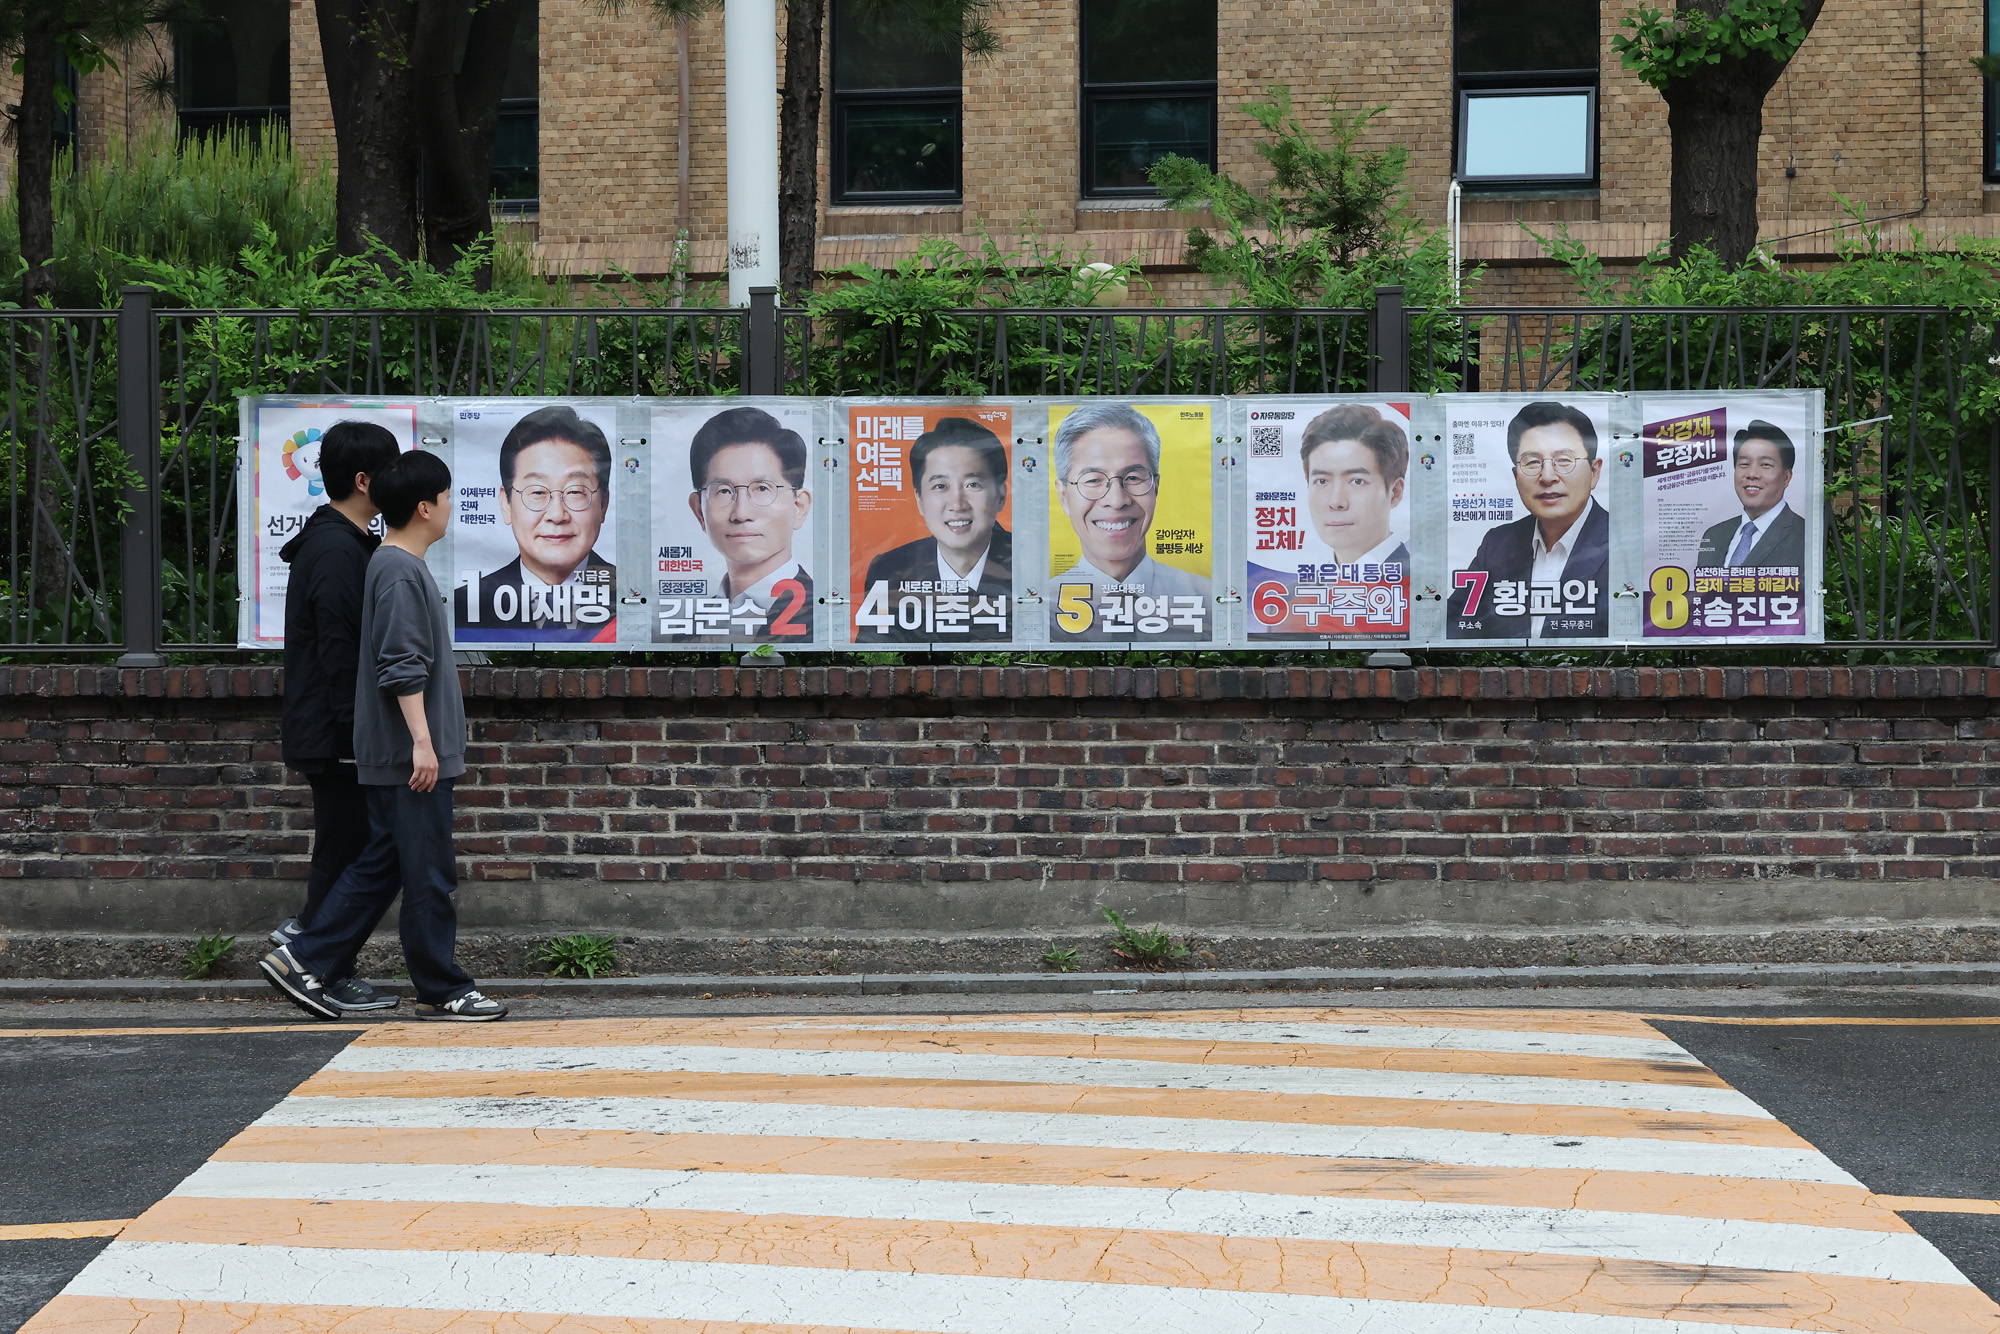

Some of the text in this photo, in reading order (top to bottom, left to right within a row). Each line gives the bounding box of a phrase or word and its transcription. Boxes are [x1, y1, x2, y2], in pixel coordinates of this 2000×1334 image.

[460, 412, 481, 420] 민주당
[1260, 411, 1295, 420] 자유통일당
[856, 416, 924, 441] 미래를
[1452, 420, 1505, 428] 출마엔 이유가 있다!
[1656, 415, 1715, 445] 선경제,
[856, 442, 902, 466] 여는
[1656, 438, 1717, 470] 후정치!
[856, 467, 902, 492] 선택
[460, 487, 496, 498] 이제부터
[1255, 491, 1296, 501] 광화문정신
[460, 501, 479, 512] 진짜
[1452, 498, 1514, 509] 부정선거 척결로
[460, 514, 496, 525] 대한민국
[1255, 507, 1296, 527] 정치
[1452, 510, 1513, 521] 청년에게 미래를
[267, 514, 308, 536] 선거
[1155, 529, 1195, 541] 갈아엎자!
[1255, 530, 1305, 550] 교체!
[658, 546, 692, 559] 새롭게
[1155, 543, 1203, 554] 불평등 세상
[658, 560, 703, 572] 대한민국
[1695, 567, 1799, 577] 실천하는 준비된 경제대통령
[573, 570, 610, 583] 지금은
[661, 582, 705, 594] 정정당당
[898, 580, 969, 593] 새로운 대통령
[1101, 583, 1145, 594] 진보대통령
[1695, 577, 1801, 593] 경제·금융 해결사
[461, 569, 611, 624] 1 이재명
[1454, 570, 1599, 616] 7 황교안
[1650, 566, 1800, 630] 8 송진호
[658, 579, 807, 636] 김문수 2
[855, 580, 1007, 634] 4 이준석
[1056, 583, 1206, 634] 5 권영국
[1252, 581, 1407, 627] 6 구주와
[1693, 597, 1702, 627] 무소속
[1458, 619, 1483, 630] 무소속
[1550, 619, 1593, 630] 전 국무총리
